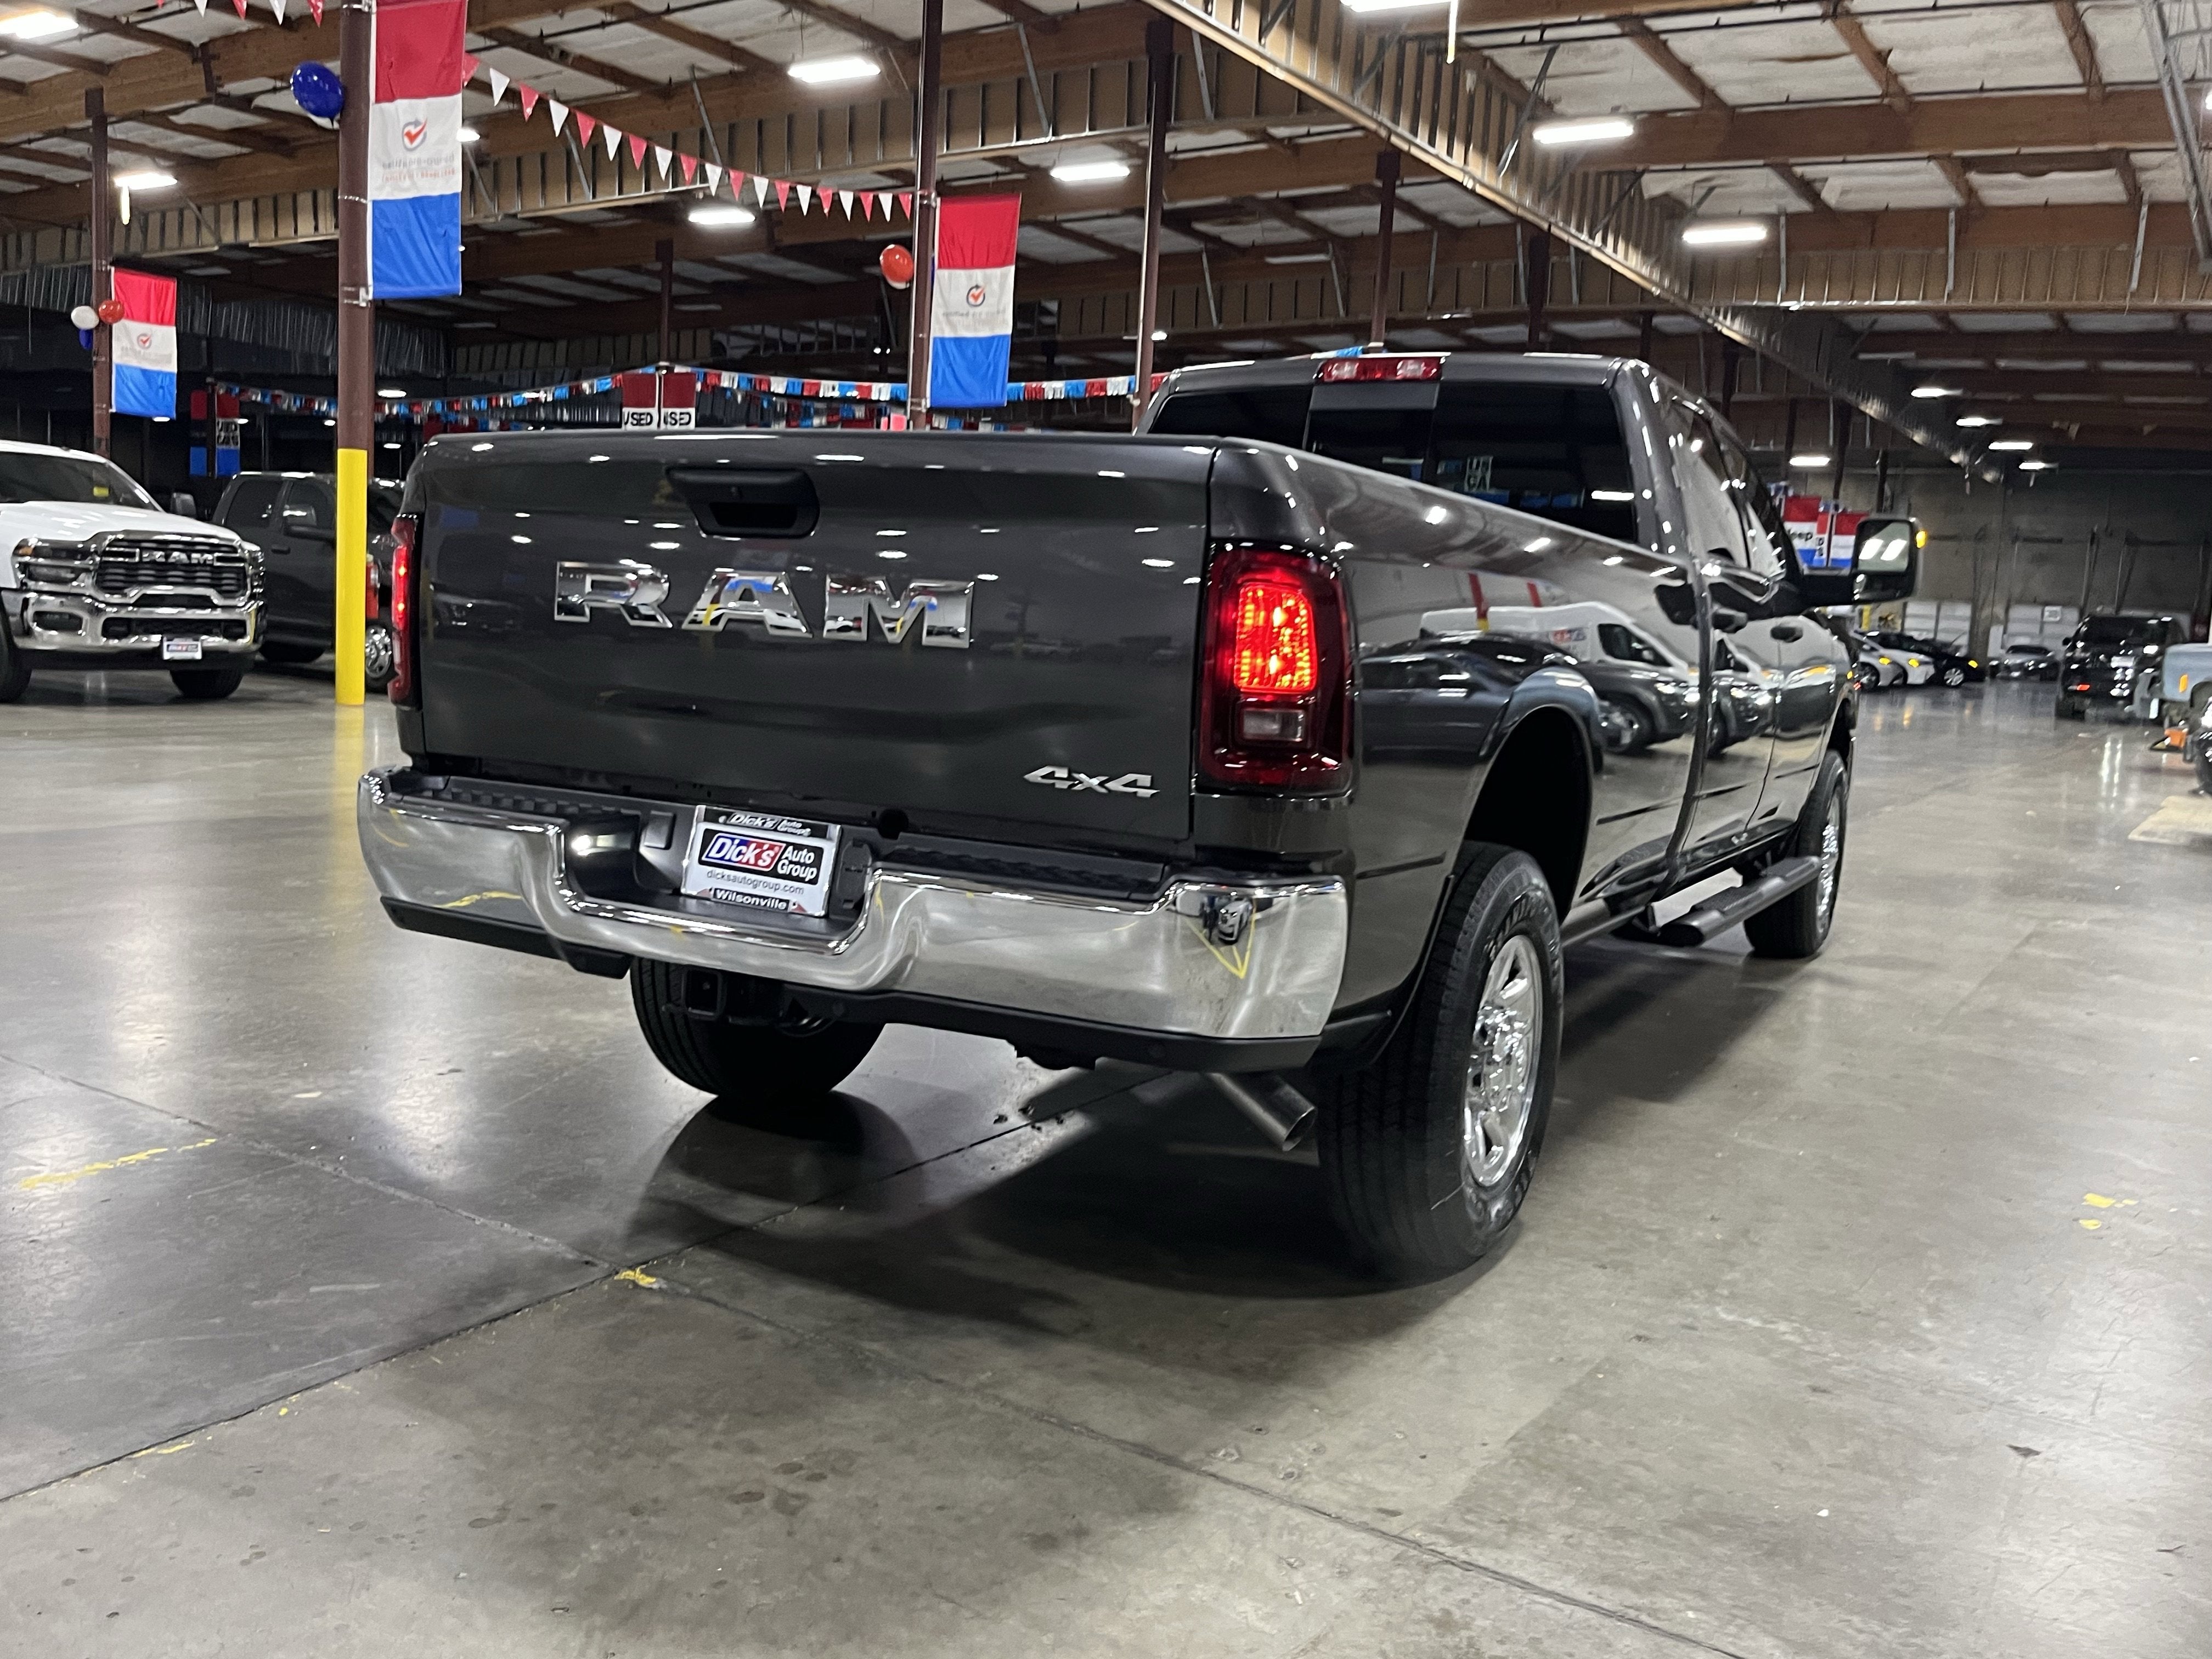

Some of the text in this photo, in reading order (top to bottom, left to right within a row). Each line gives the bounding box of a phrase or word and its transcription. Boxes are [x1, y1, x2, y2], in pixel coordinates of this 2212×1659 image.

[142, 551, 214, 565] RAM
[554, 561, 974, 648] RAM
[1023, 765, 1161, 798] 4x4
[730, 814, 776, 828] Dick's
[708, 837, 815, 867] Dick's Auto
[707, 869, 804, 895] dicksautogroup.com
[777, 860, 818, 882] Group
[715, 889, 787, 911] Wilsonville
